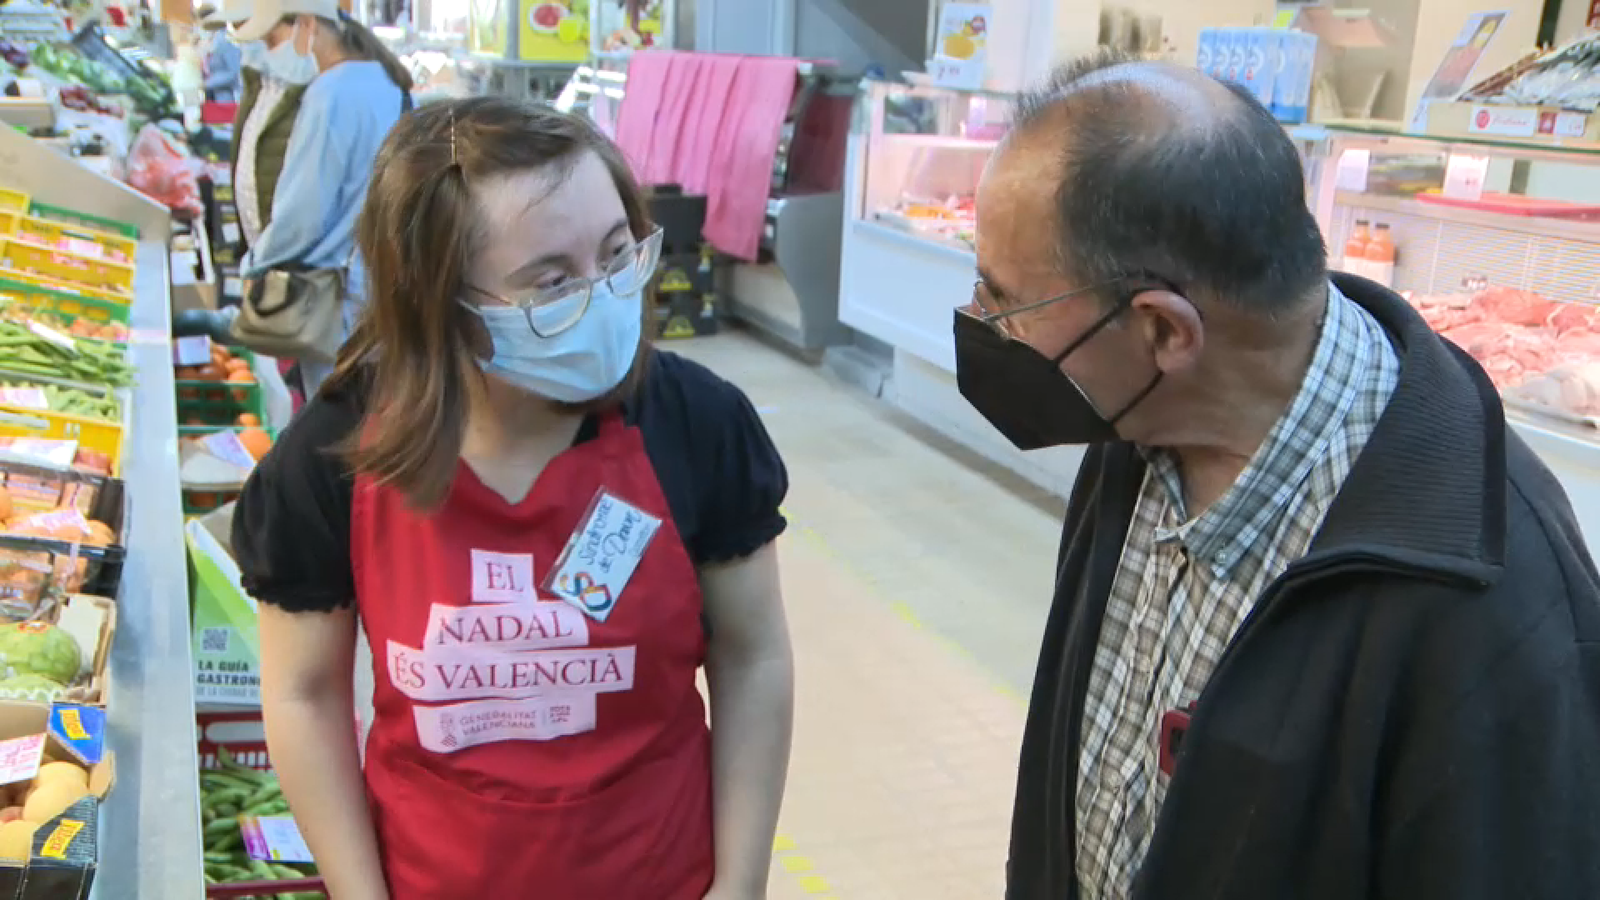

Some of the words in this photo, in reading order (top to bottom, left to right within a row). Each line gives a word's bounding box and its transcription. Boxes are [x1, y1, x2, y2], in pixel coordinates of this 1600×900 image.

[601, 509, 643, 557] Down
[485, 561, 525, 593] EL
[437, 610, 574, 645] NADAL
[198, 660, 213, 671] LA
[217, 659, 248, 673] GUÍA
[393, 652, 426, 689] ÉS
[435, 652, 625, 690] VALENCIÀ
